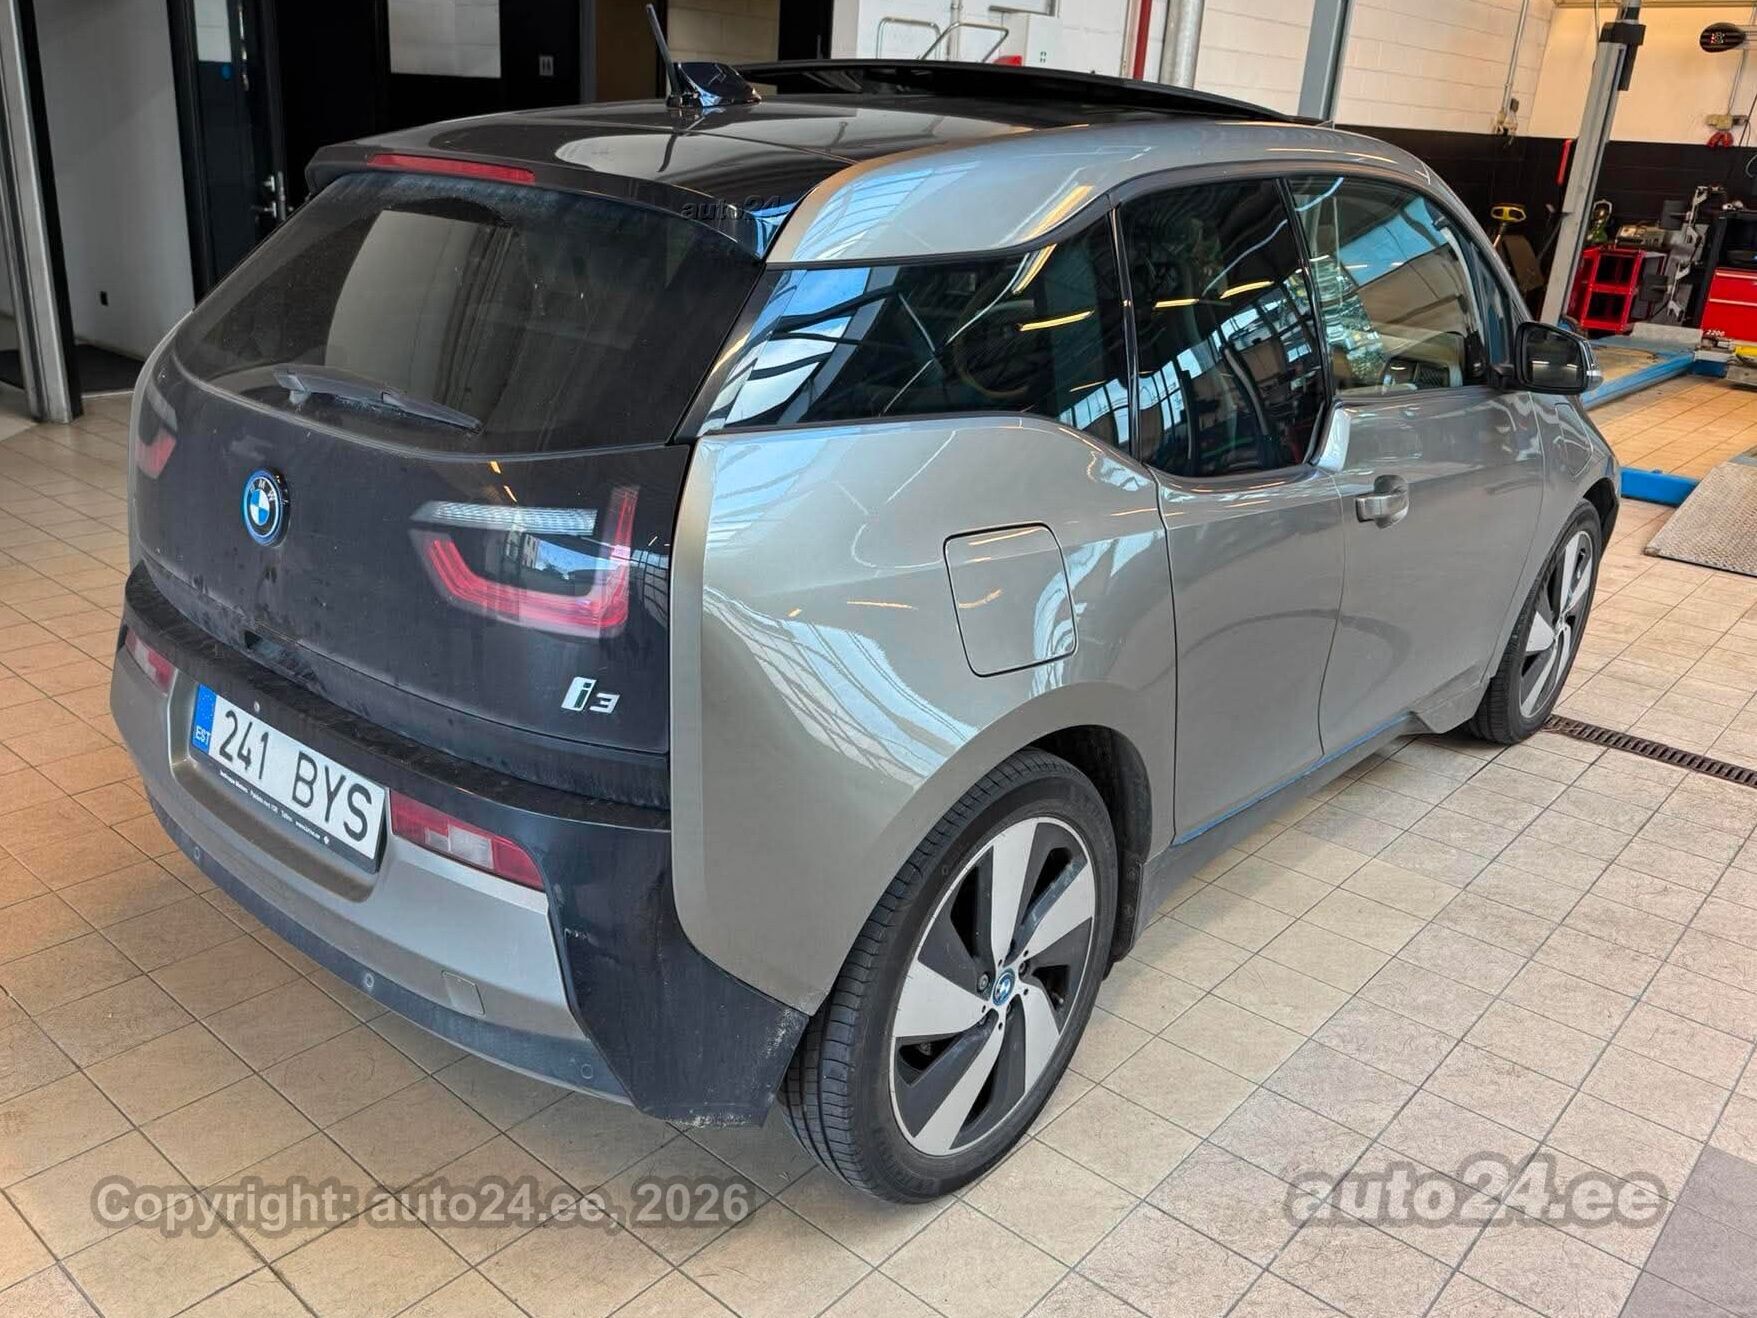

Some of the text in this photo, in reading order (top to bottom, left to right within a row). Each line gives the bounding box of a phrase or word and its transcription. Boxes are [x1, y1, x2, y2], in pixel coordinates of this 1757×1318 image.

[561, 676, 620, 714] i3
[195, 725, 210, 746] EST
[219, 709, 270, 780] 241
[291, 750, 373, 843] BYS
